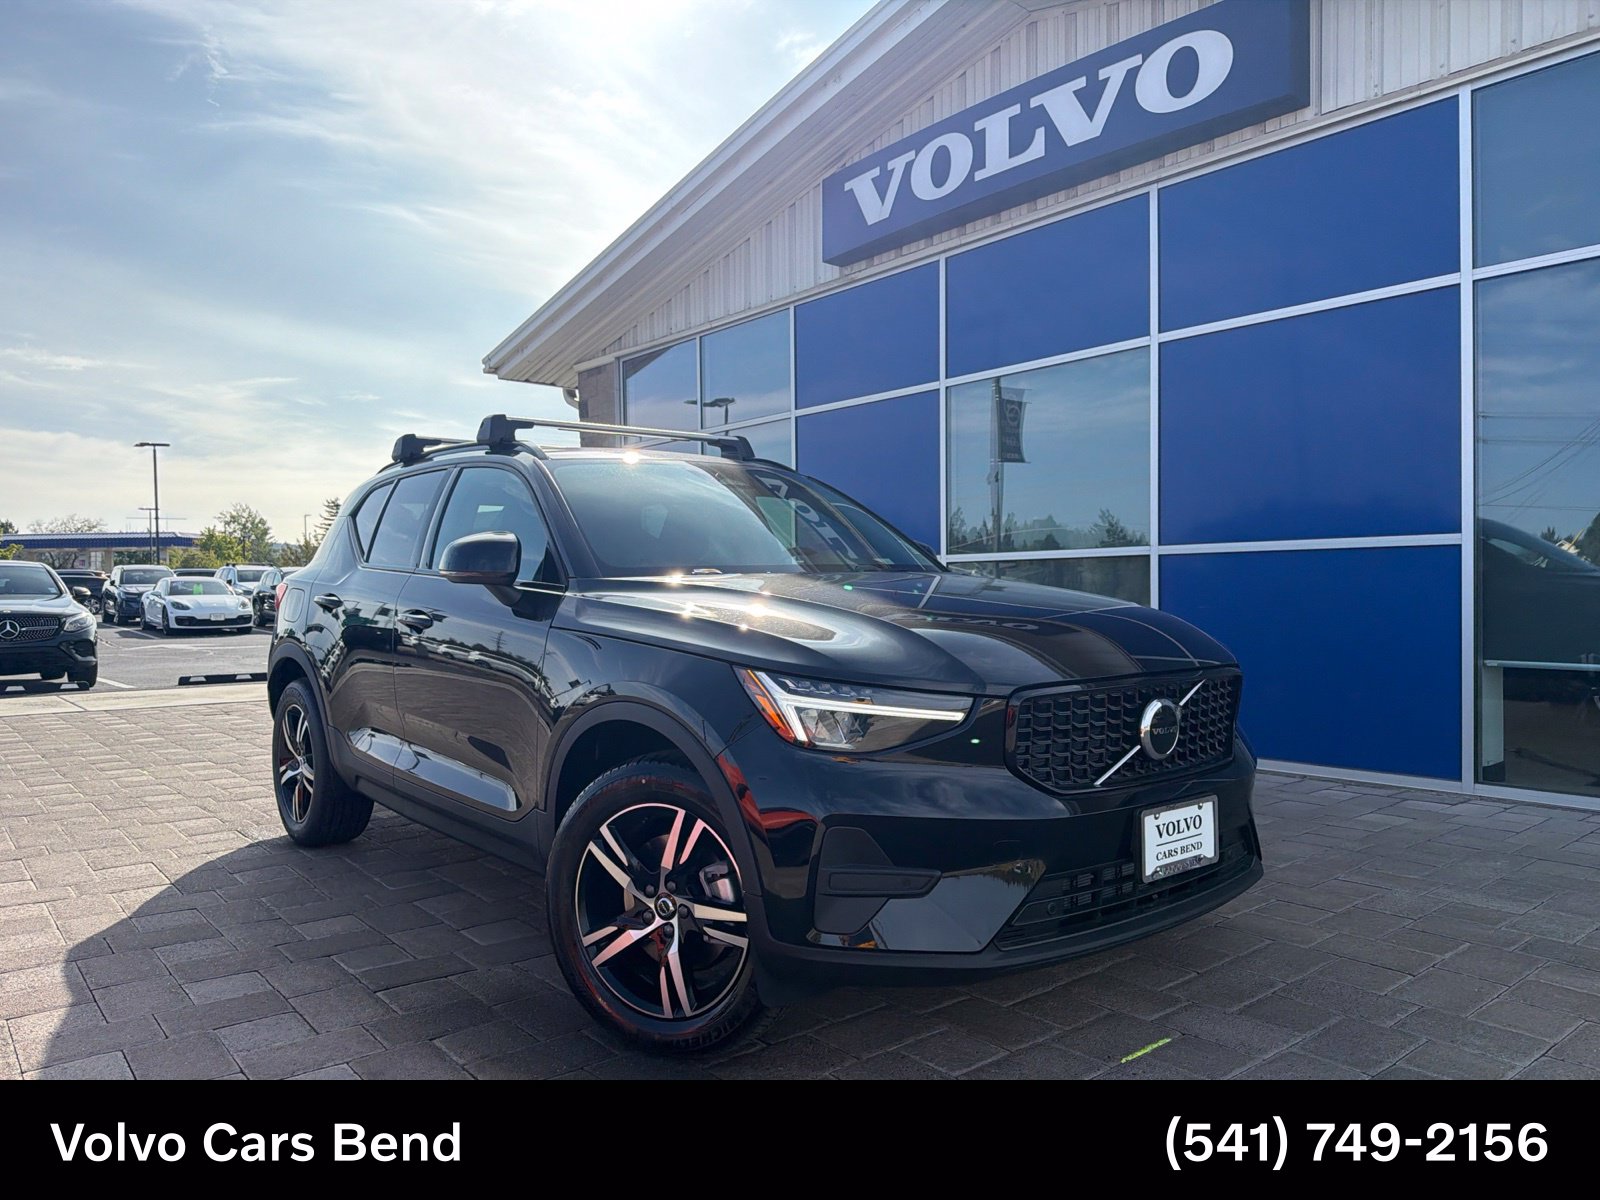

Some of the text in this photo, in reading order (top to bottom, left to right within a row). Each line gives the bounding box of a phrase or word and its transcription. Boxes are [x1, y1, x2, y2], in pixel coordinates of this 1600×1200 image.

[844, 29, 1234, 226] VOLVO
[1155, 814, 1203, 839] VOLVO
[1156, 841, 1203, 861] CARS BEND
